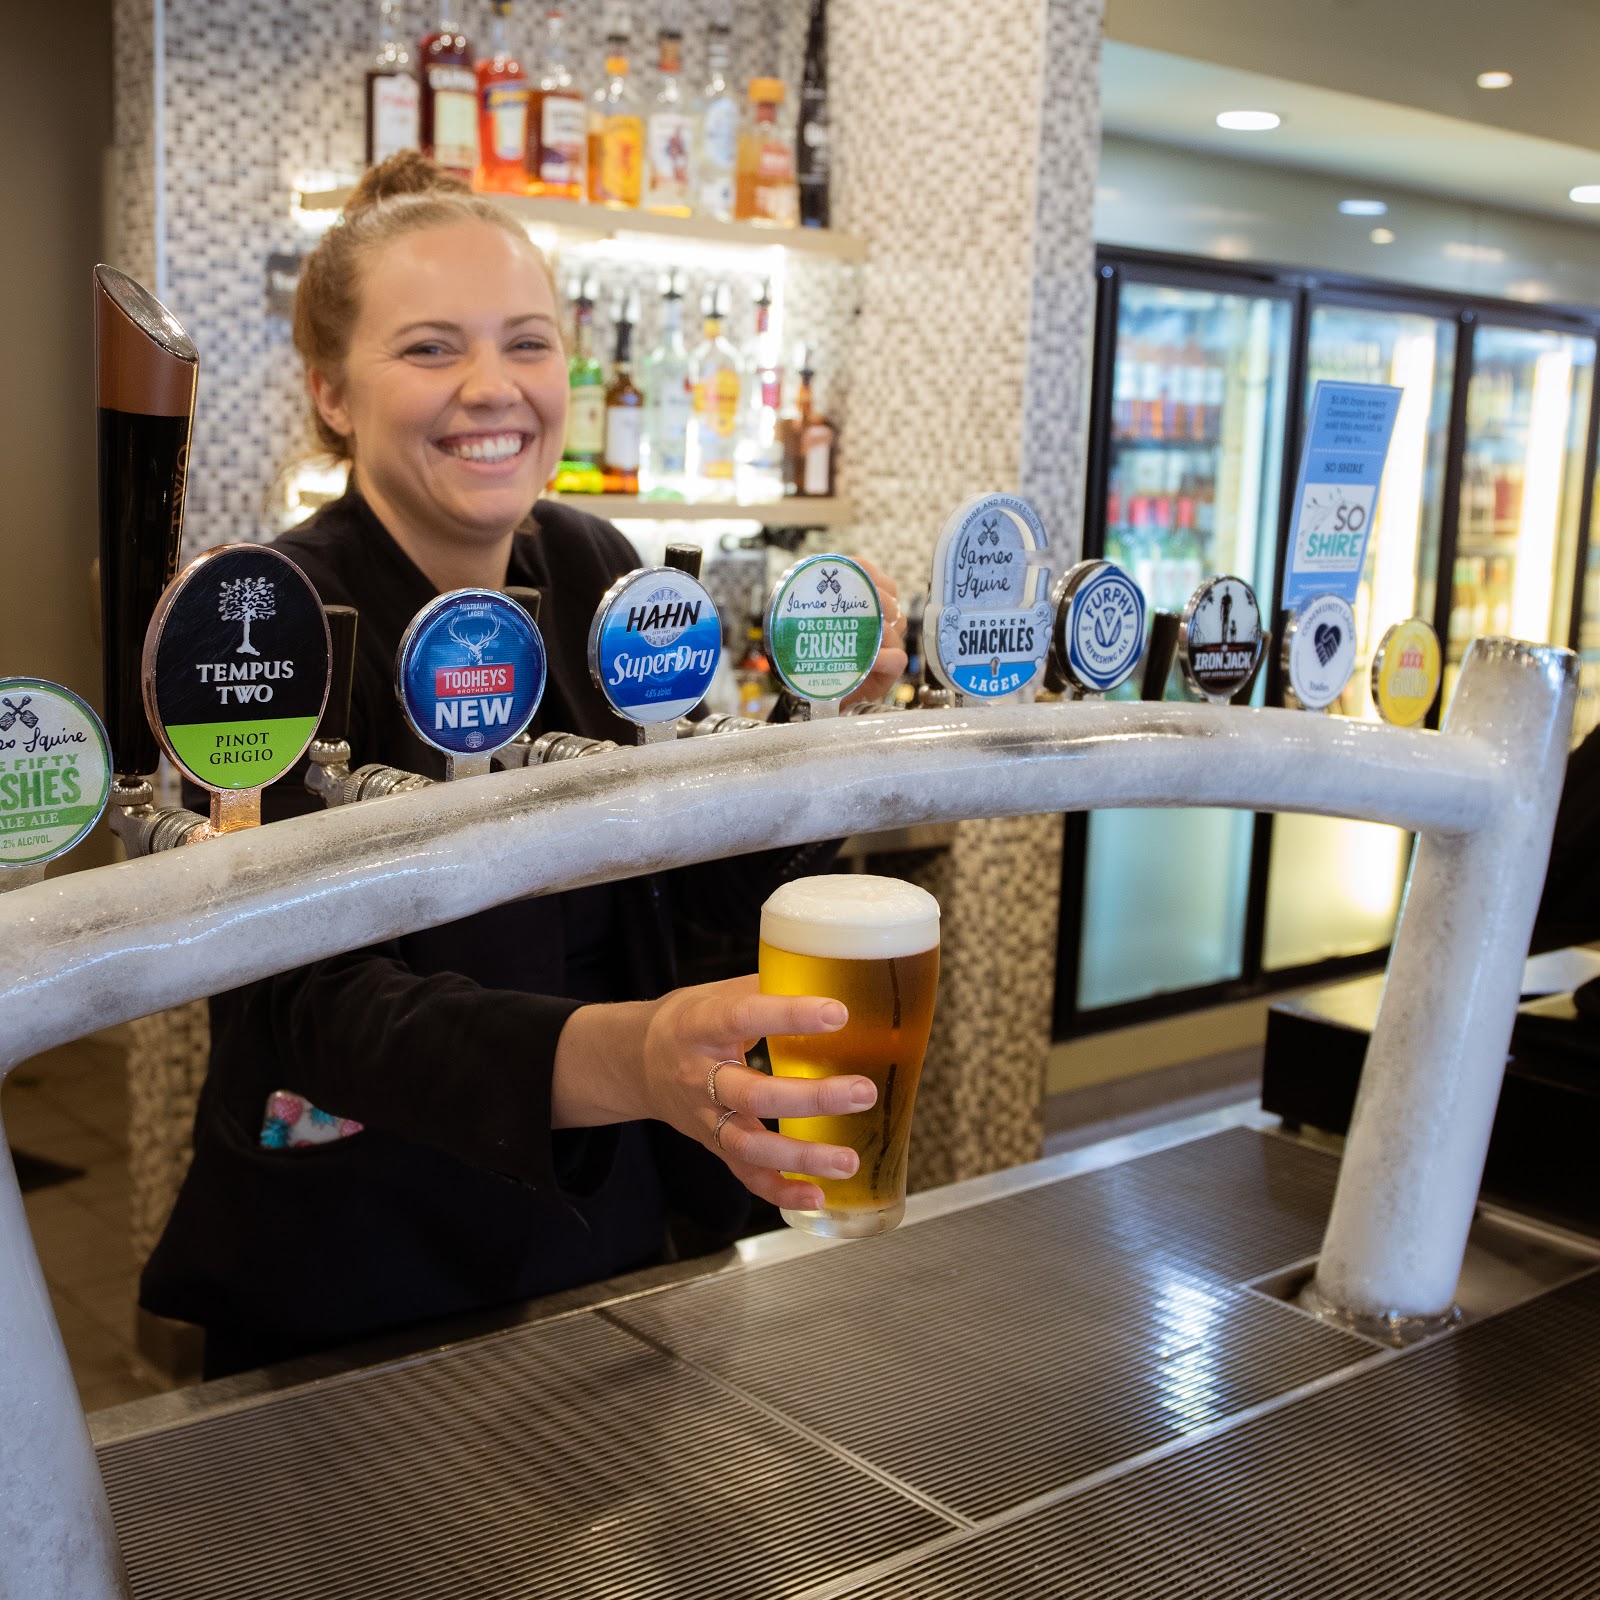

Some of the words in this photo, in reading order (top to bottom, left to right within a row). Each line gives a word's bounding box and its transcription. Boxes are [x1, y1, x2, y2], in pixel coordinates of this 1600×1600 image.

[1325, 462, 1337, 473] SO
[1338, 463, 1364, 474] SHIRE
[962, 507, 981, 530] CRISP
[983, 498, 999, 509] AND
[1001, 498, 1040, 530] REFRESHING
[1334, 505, 1366, 532] SO
[958, 536, 1013, 570] James
[1306, 533, 1363, 558] SHIRE
[957, 566, 1011, 599] Squire
[459, 602, 492, 610] AUSTRALIAN
[787, 591, 827, 613] James
[831, 594, 869, 613] Squire
[1085, 587, 1135, 619] FURPHY
[626, 600, 702, 632] HAHN
[798, 619, 859, 631] ORCHARD
[969, 618, 1026, 628] BROKEN
[1302, 603, 1343, 637] COMMUNITY
[795, 632, 858, 660] CRUSH
[958, 627, 1034, 656] SHACKLES
[1084, 639, 1118, 664] REFRESHING
[1118, 638, 1129, 656] ALE
[196, 660, 294, 683] TEMPUS
[794, 662, 825, 672] APPLE
[827, 662, 858, 672] CIDER
[1194, 652, 1223, 671] IRON
[1223, 651, 1252, 670] JACK
[443, 669, 507, 690] TOOHEYS
[968, 673, 1020, 693] LAGER
[216, 684, 274, 705] TWO
[435, 697, 514, 730] NEW
[22, 727, 88, 753] Squire
[216, 732, 270, 748] PINOT
[14, 753, 79, 771] FIFTY
[210, 749, 273, 765] GRIGIO
[0, 767, 82, 811] SHES
[0, 816, 26, 830] ALE
[30, 812, 59, 826] ALE
[17, 834, 53, 847] ALC/VOL.
